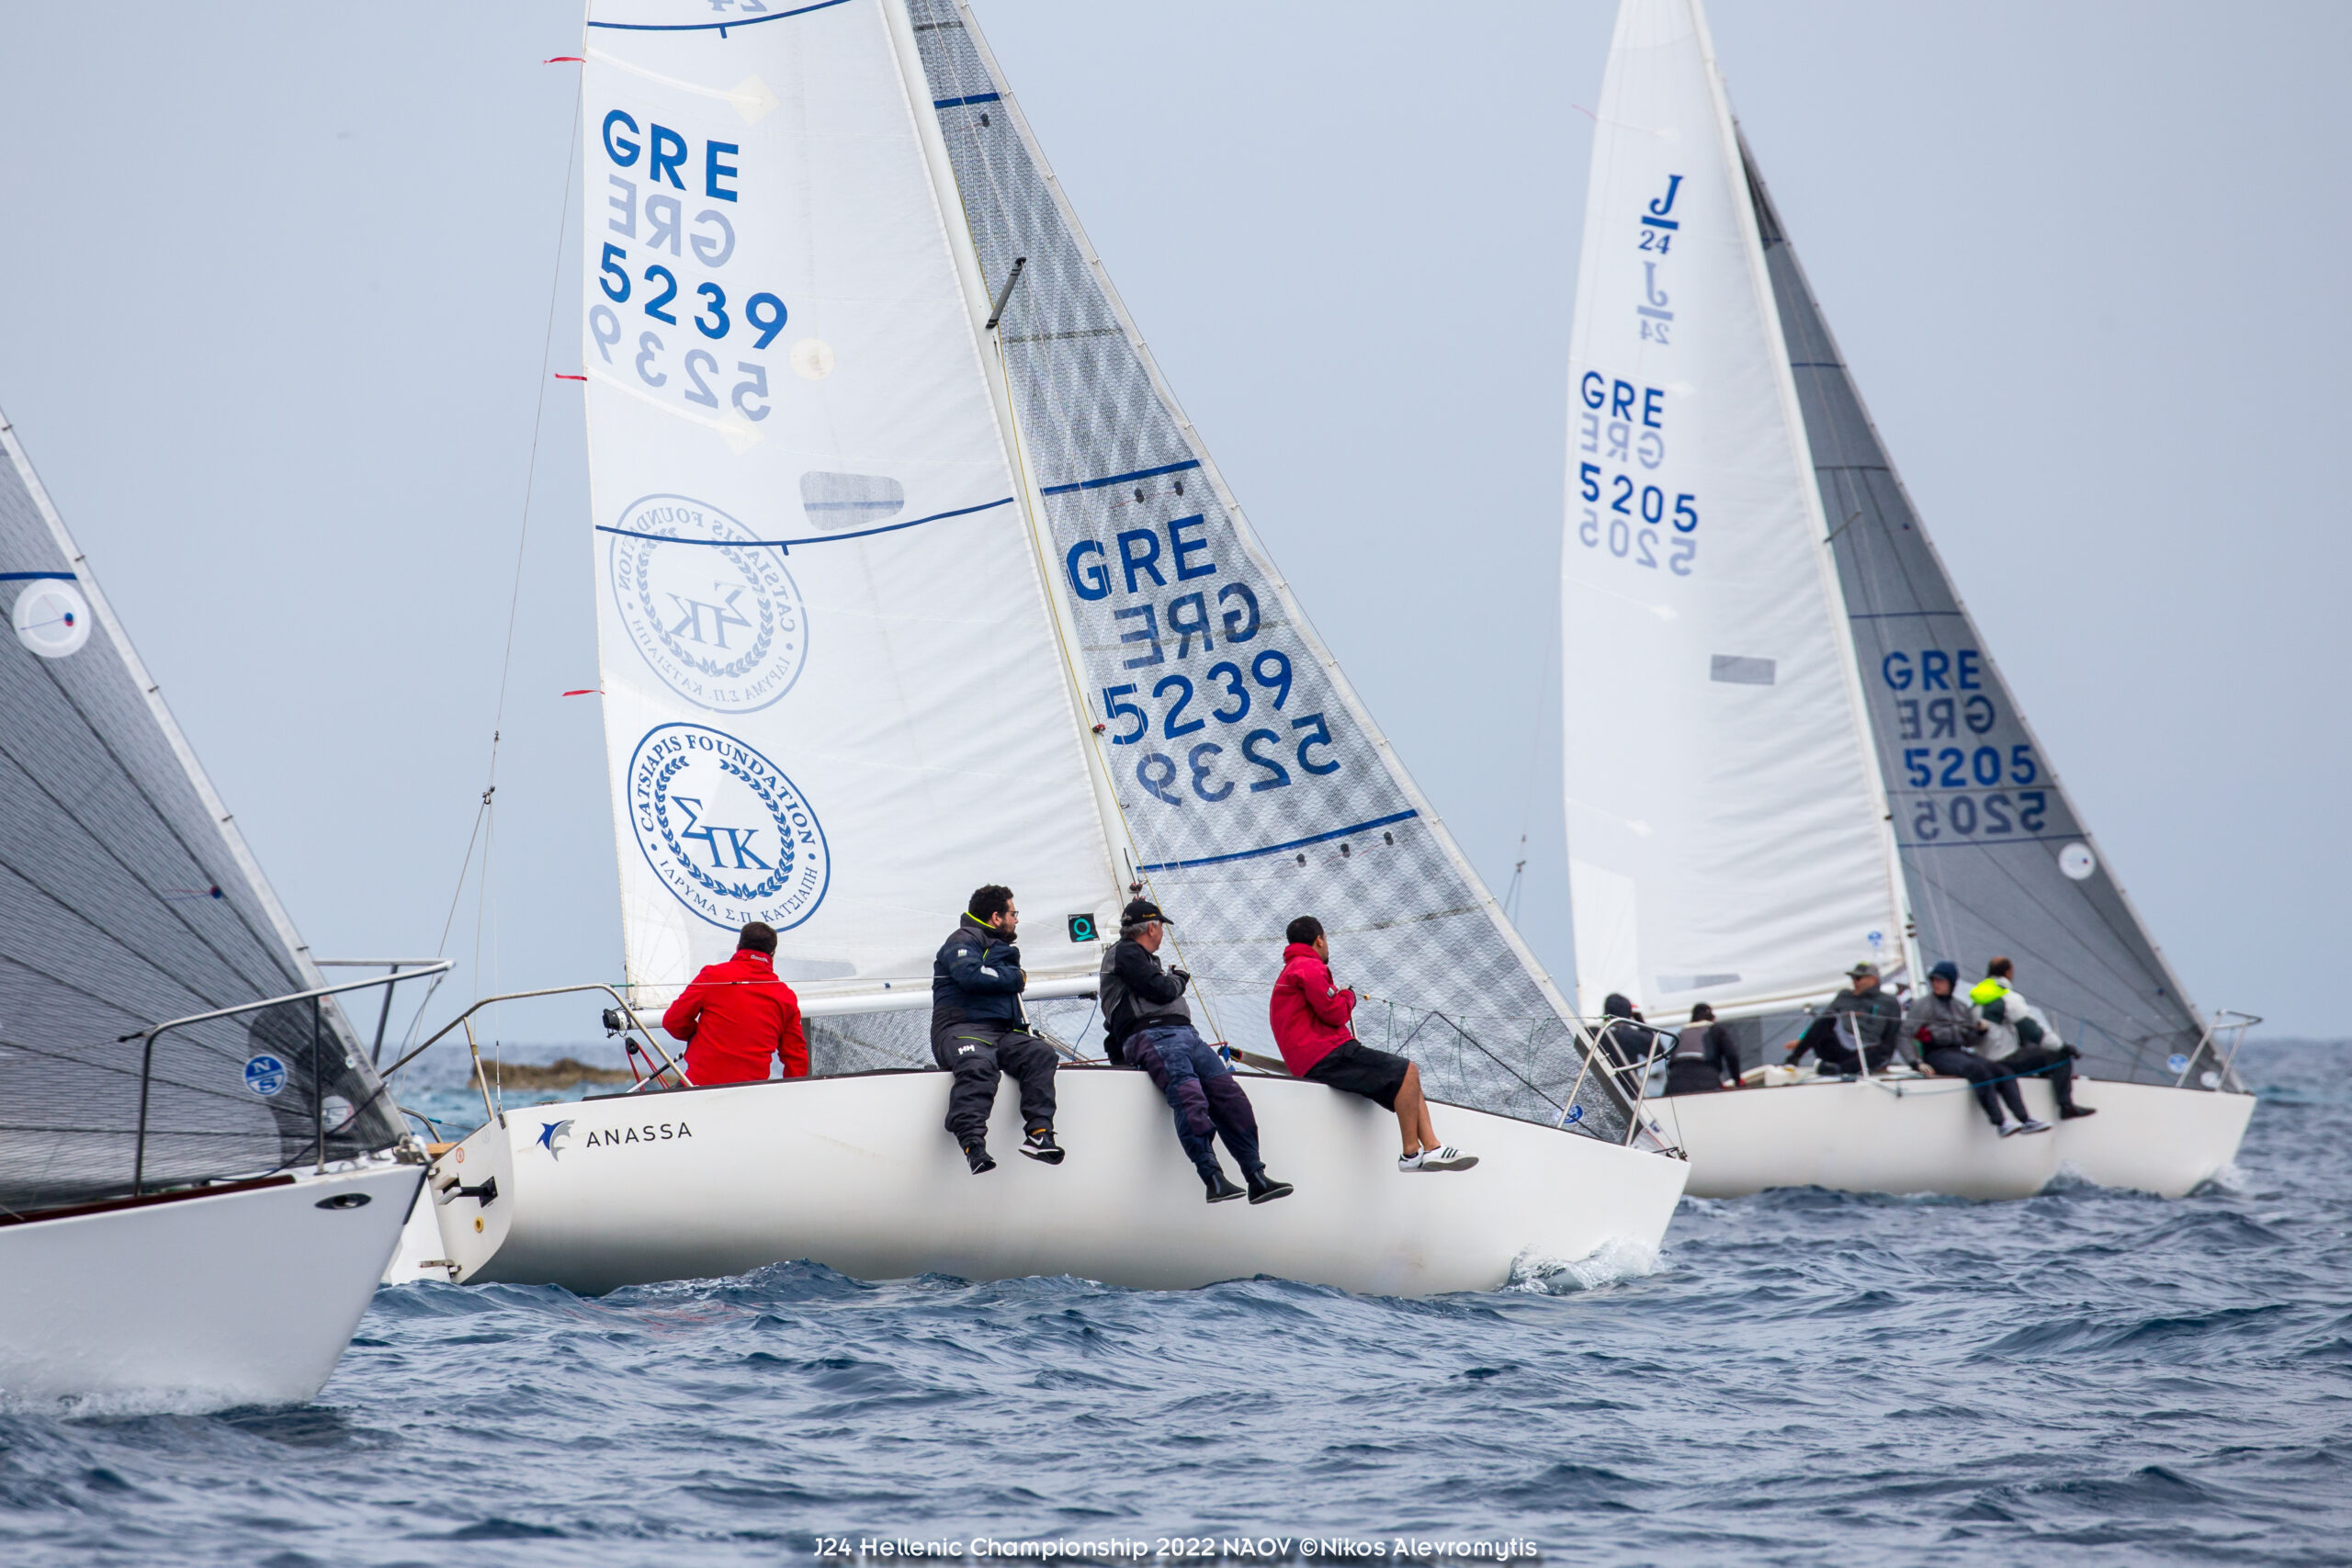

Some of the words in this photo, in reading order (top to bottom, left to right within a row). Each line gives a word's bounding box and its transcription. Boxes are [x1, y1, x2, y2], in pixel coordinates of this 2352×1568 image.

[602, 109, 739, 203] GRE
[1648, 175, 1684, 216] J
[1637, 229, 1671, 255] 24
[598, 242, 788, 350] 5239
[1581, 370, 1665, 429] GRE
[1579, 461, 1699, 534] 5205
[1066, 513, 1217, 602] GRE
[1102, 649, 1293, 745] 5239
[1882, 649, 1982, 691] GRE
[637, 736, 683, 832] CATSIAPIS
[684, 735, 816, 845] FOUNDATION
[1903, 744, 2037, 788] 5205
[659, 860, 718, 916] ΙΔΡΥΜΑ
[761, 867, 819, 923] ΚΑΤΣΙΑΠΗ
[586, 1122, 693, 1148] ANASSA
